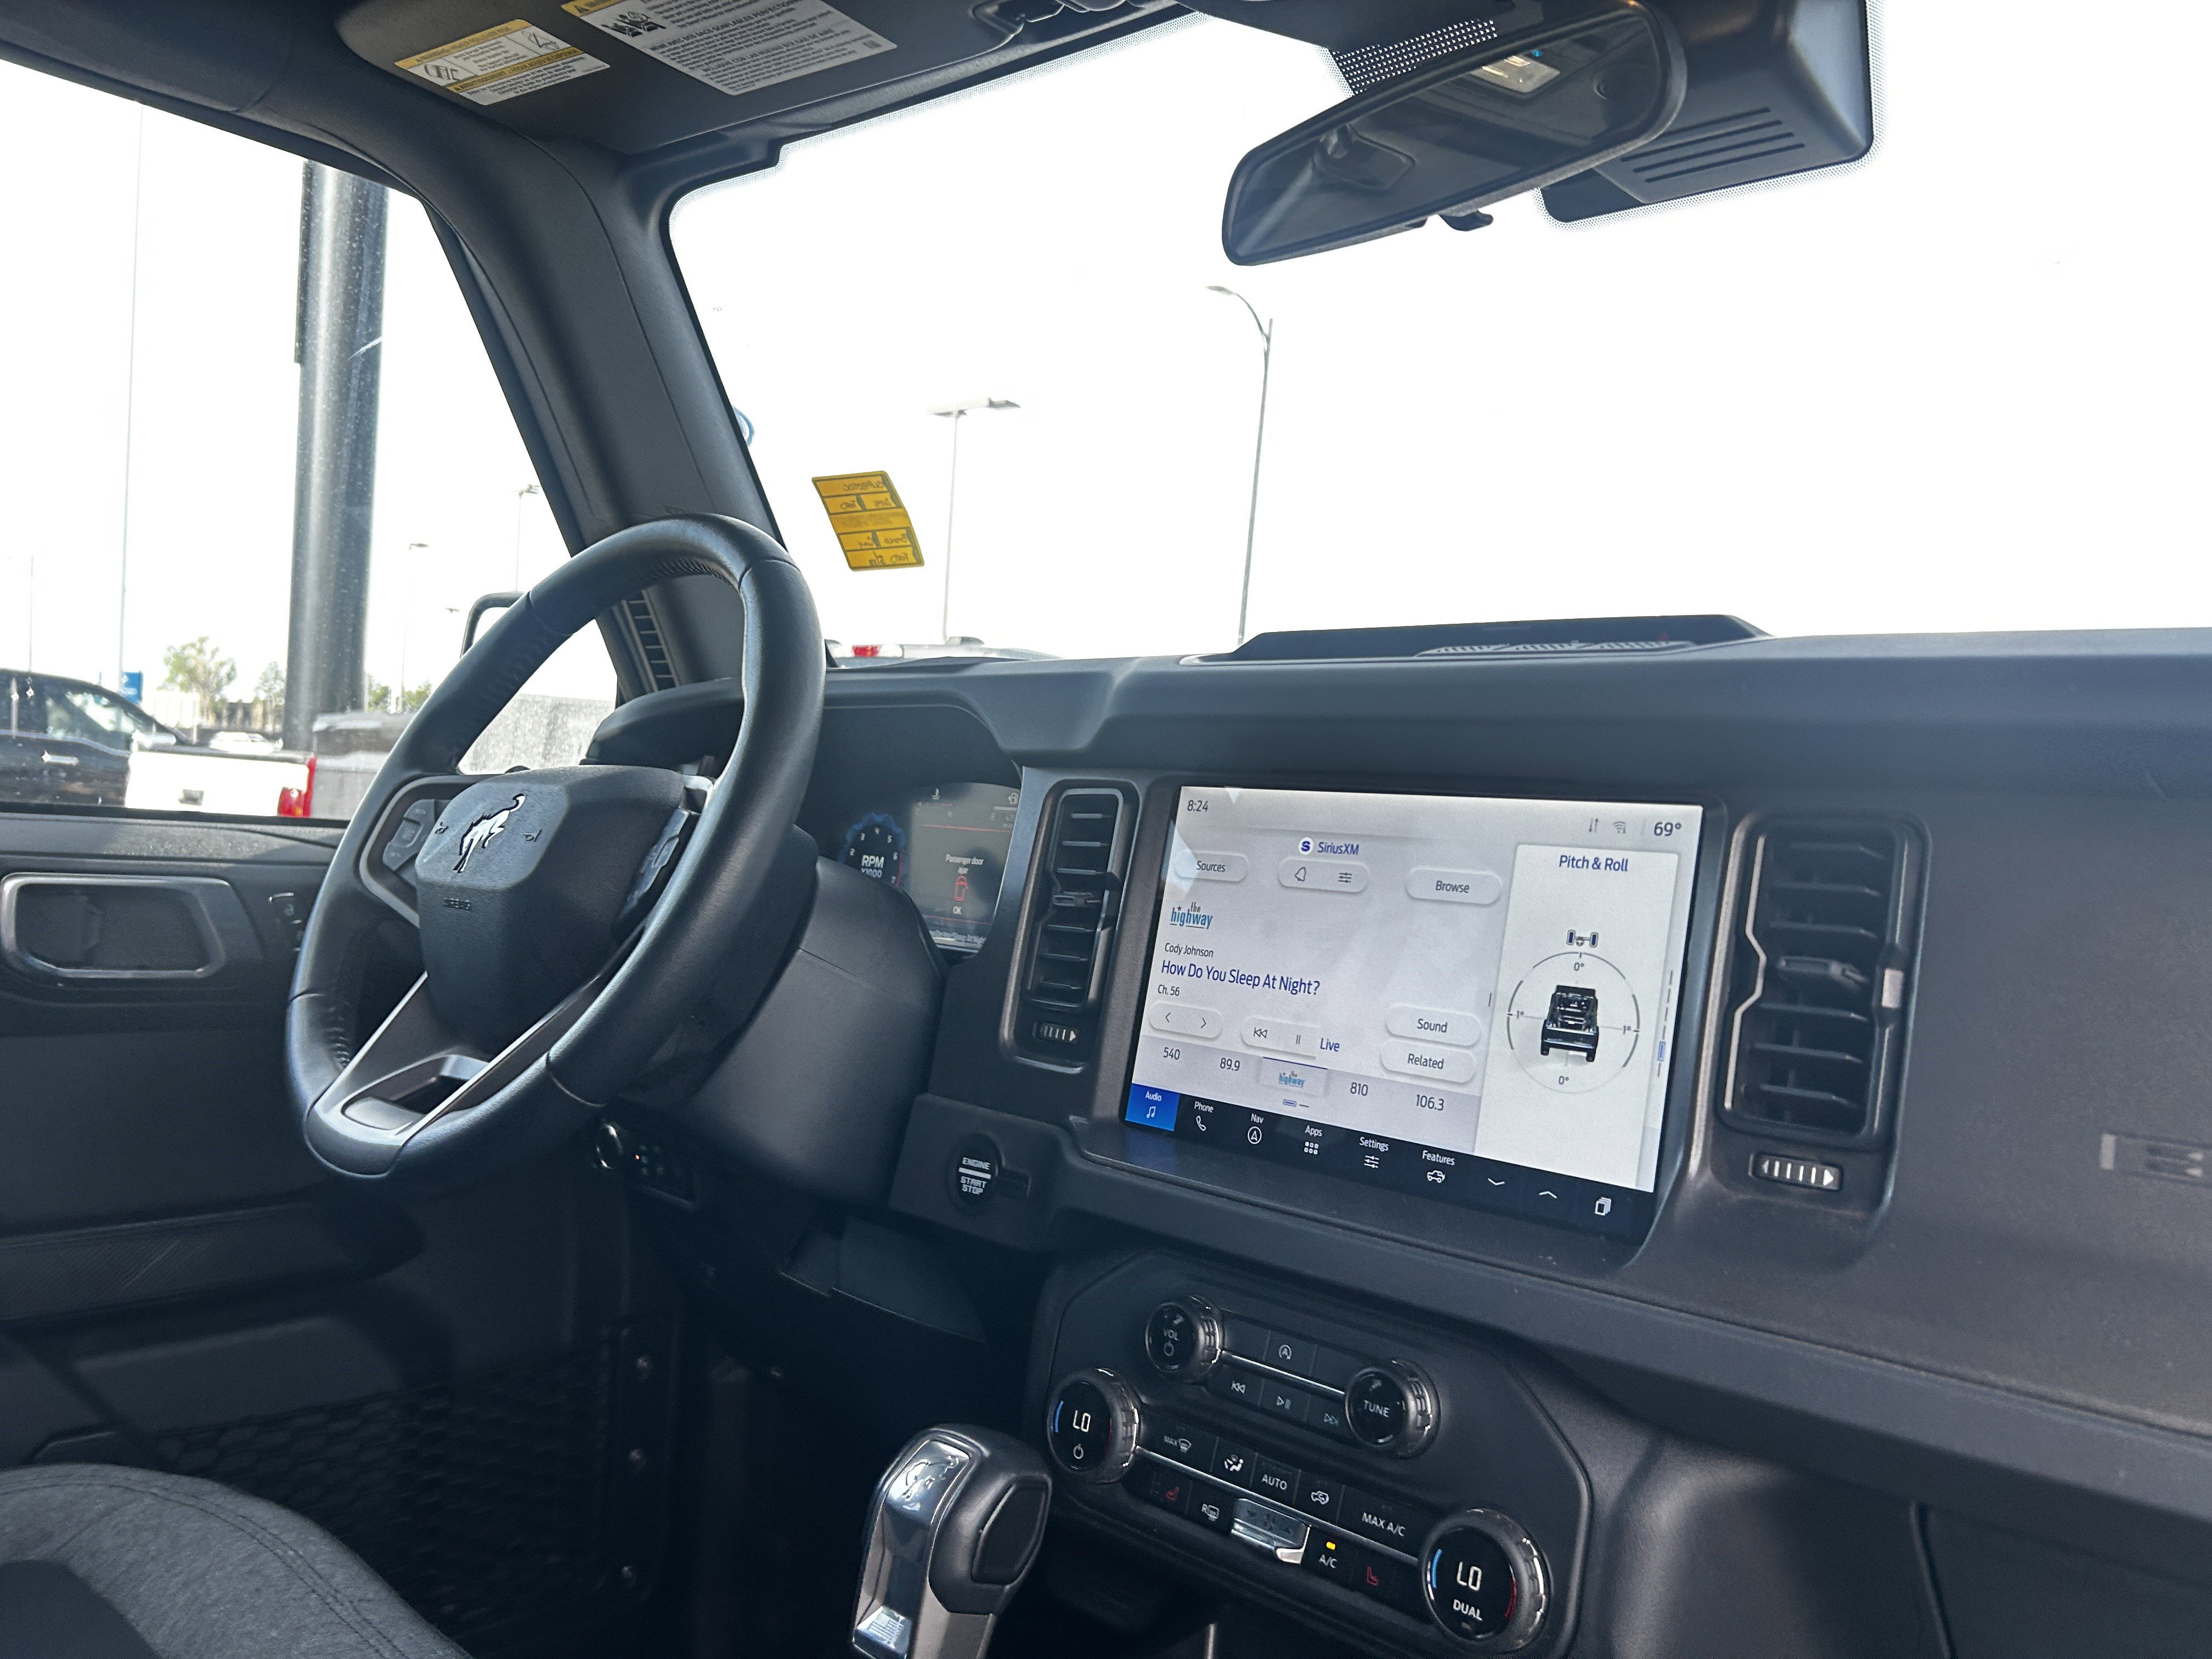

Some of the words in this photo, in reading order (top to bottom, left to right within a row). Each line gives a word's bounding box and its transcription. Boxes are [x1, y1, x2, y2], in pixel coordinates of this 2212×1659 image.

[1187, 800, 1208, 812] 8:24
[1654, 822, 1682, 837] 69°
[1317, 842, 1359, 855] SiriusXM
[861, 854, 884, 868] RPM
[1196, 861, 1226, 872] Sources
[1559, 855, 1589, 869] Pitch
[1592, 857, 1601, 870] &
[1605, 857, 1628, 872] Roll
[1436, 881, 1470, 894] Browse
[1190, 901, 1201, 913] the
[1170, 907, 1213, 929] highway
[1165, 943, 1183, 955] Cody
[1184, 944, 1214, 958] Johnson
[1161, 960, 1186, 976] How
[1188, 963, 1203, 978] Do
[1206, 966, 1226, 983] You
[1228, 969, 1260, 989] Sleep
[1262, 974, 1277, 990] At
[1279, 976, 1320, 995] Night?
[1158, 984, 1169, 995] Ch.
[1170, 986, 1180, 996] 56
[1417, 1018, 1448, 1033] Sound
[1320, 1037, 1340, 1053] Live
[1163, 1047, 1181, 1060] 540
[1220, 1058, 1240, 1072] 89.9
[1407, 1053, 1444, 1070] Related
[1145, 1091, 1162, 1102] Audio
[1350, 1082, 1369, 1097] 810
[1194, 1101, 1214, 1113] Phone
[1415, 1094, 1444, 1111] 106.3
[1251, 1113, 1264, 1124] Nav
[1305, 1125, 1323, 1137] Apps
[1359, 1136, 1389, 1152] Settings
[962, 1156, 991, 1170] ENGINE
[1422, 1150, 1455, 1166] Features
[961, 1176, 986, 1188] START
[962, 1184, 984, 1195] STOP
[1163, 1328, 1179, 1341] VOL
[1363, 1400, 1390, 1418] TUNE
[1072, 1410, 1091, 1432] LO
[1261, 1474, 1288, 1491] AUTO
[1361, 1511, 1385, 1527] MAX
[1384, 1521, 1406, 1537] A/C
[1319, 1553, 1337, 1569] A/C
[1456, 1561, 1482, 1591] LO
[1453, 1599, 1483, 1621] DUAL
